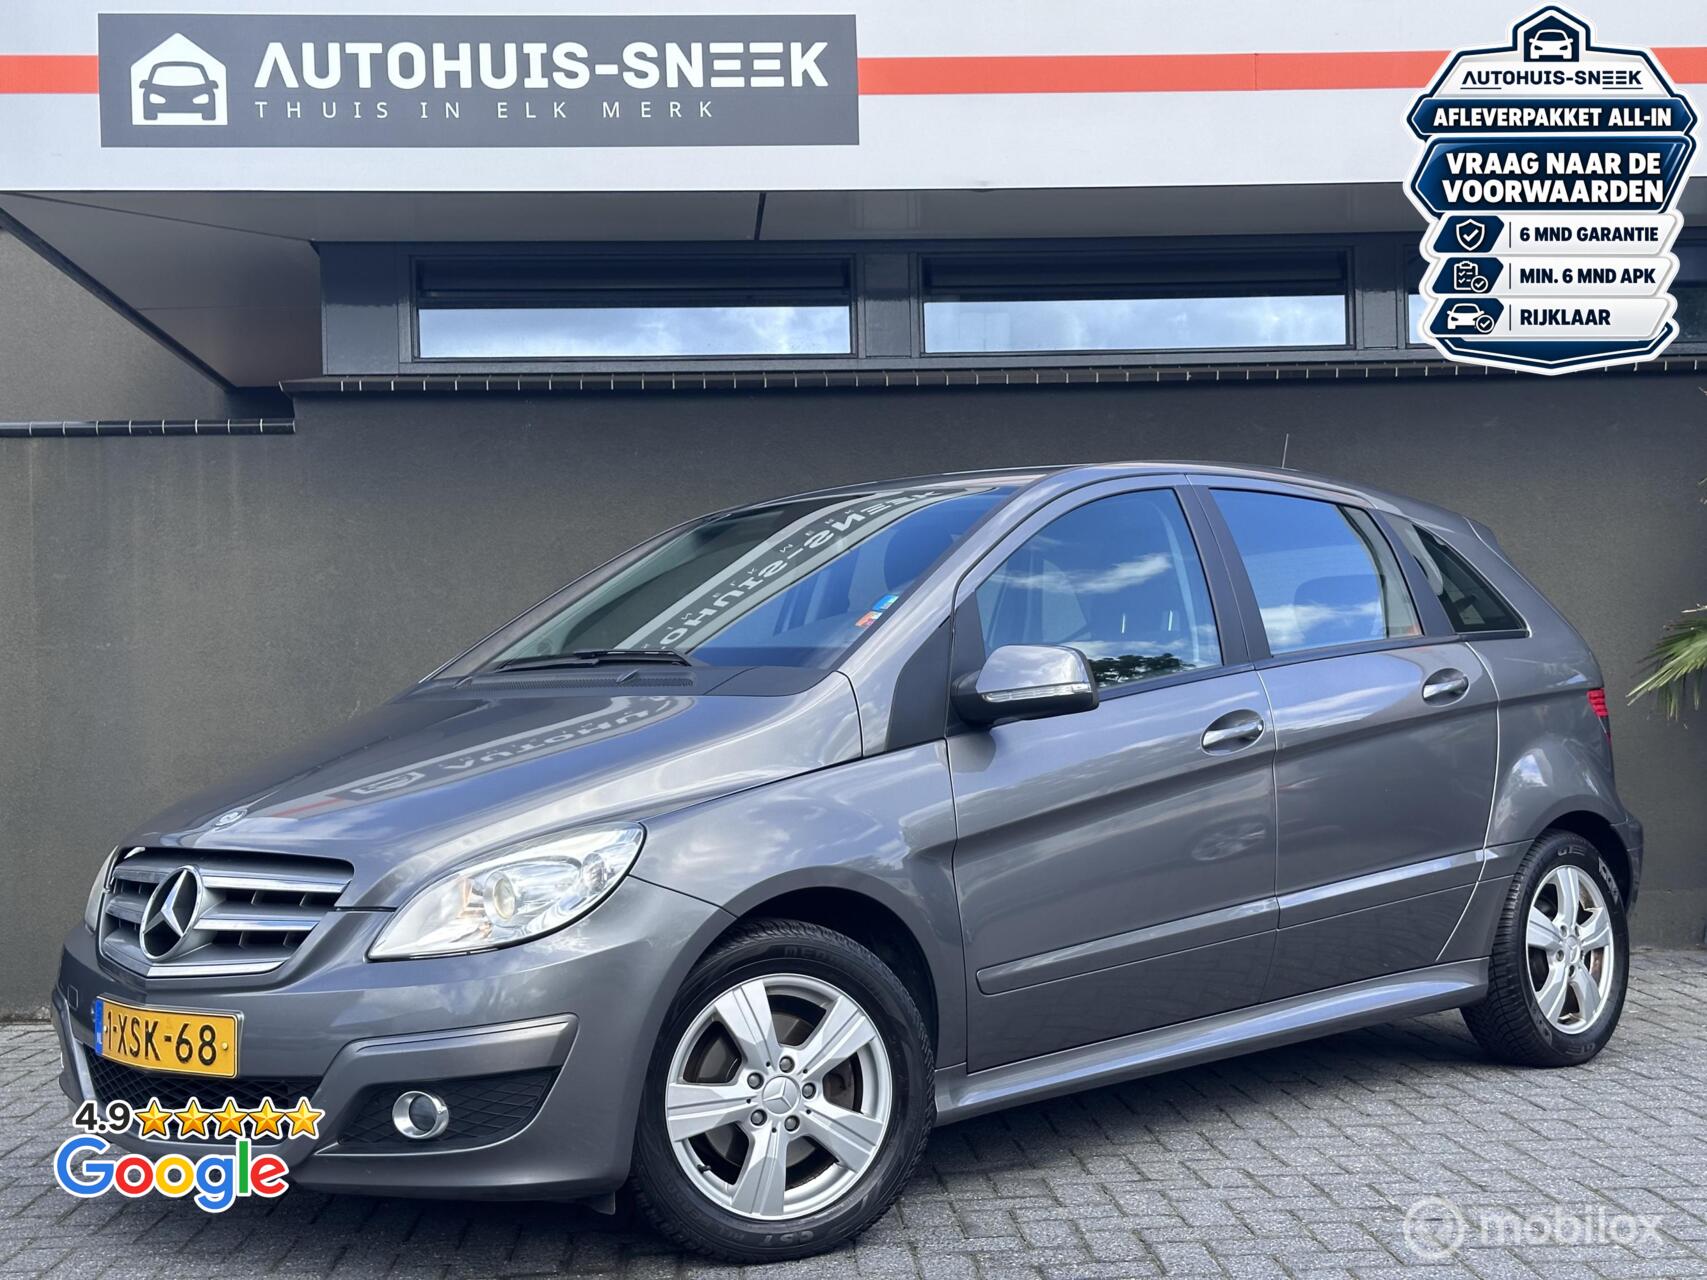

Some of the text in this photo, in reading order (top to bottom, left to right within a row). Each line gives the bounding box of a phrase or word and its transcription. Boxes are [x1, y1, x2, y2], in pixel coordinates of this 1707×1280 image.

[254, 41, 829, 90] AUTOHUIS-SNEEK
[254, 100, 713, 119] THUIS IN ELK MERK
[106, 1010, 217, 1066] 1-XSK-68
